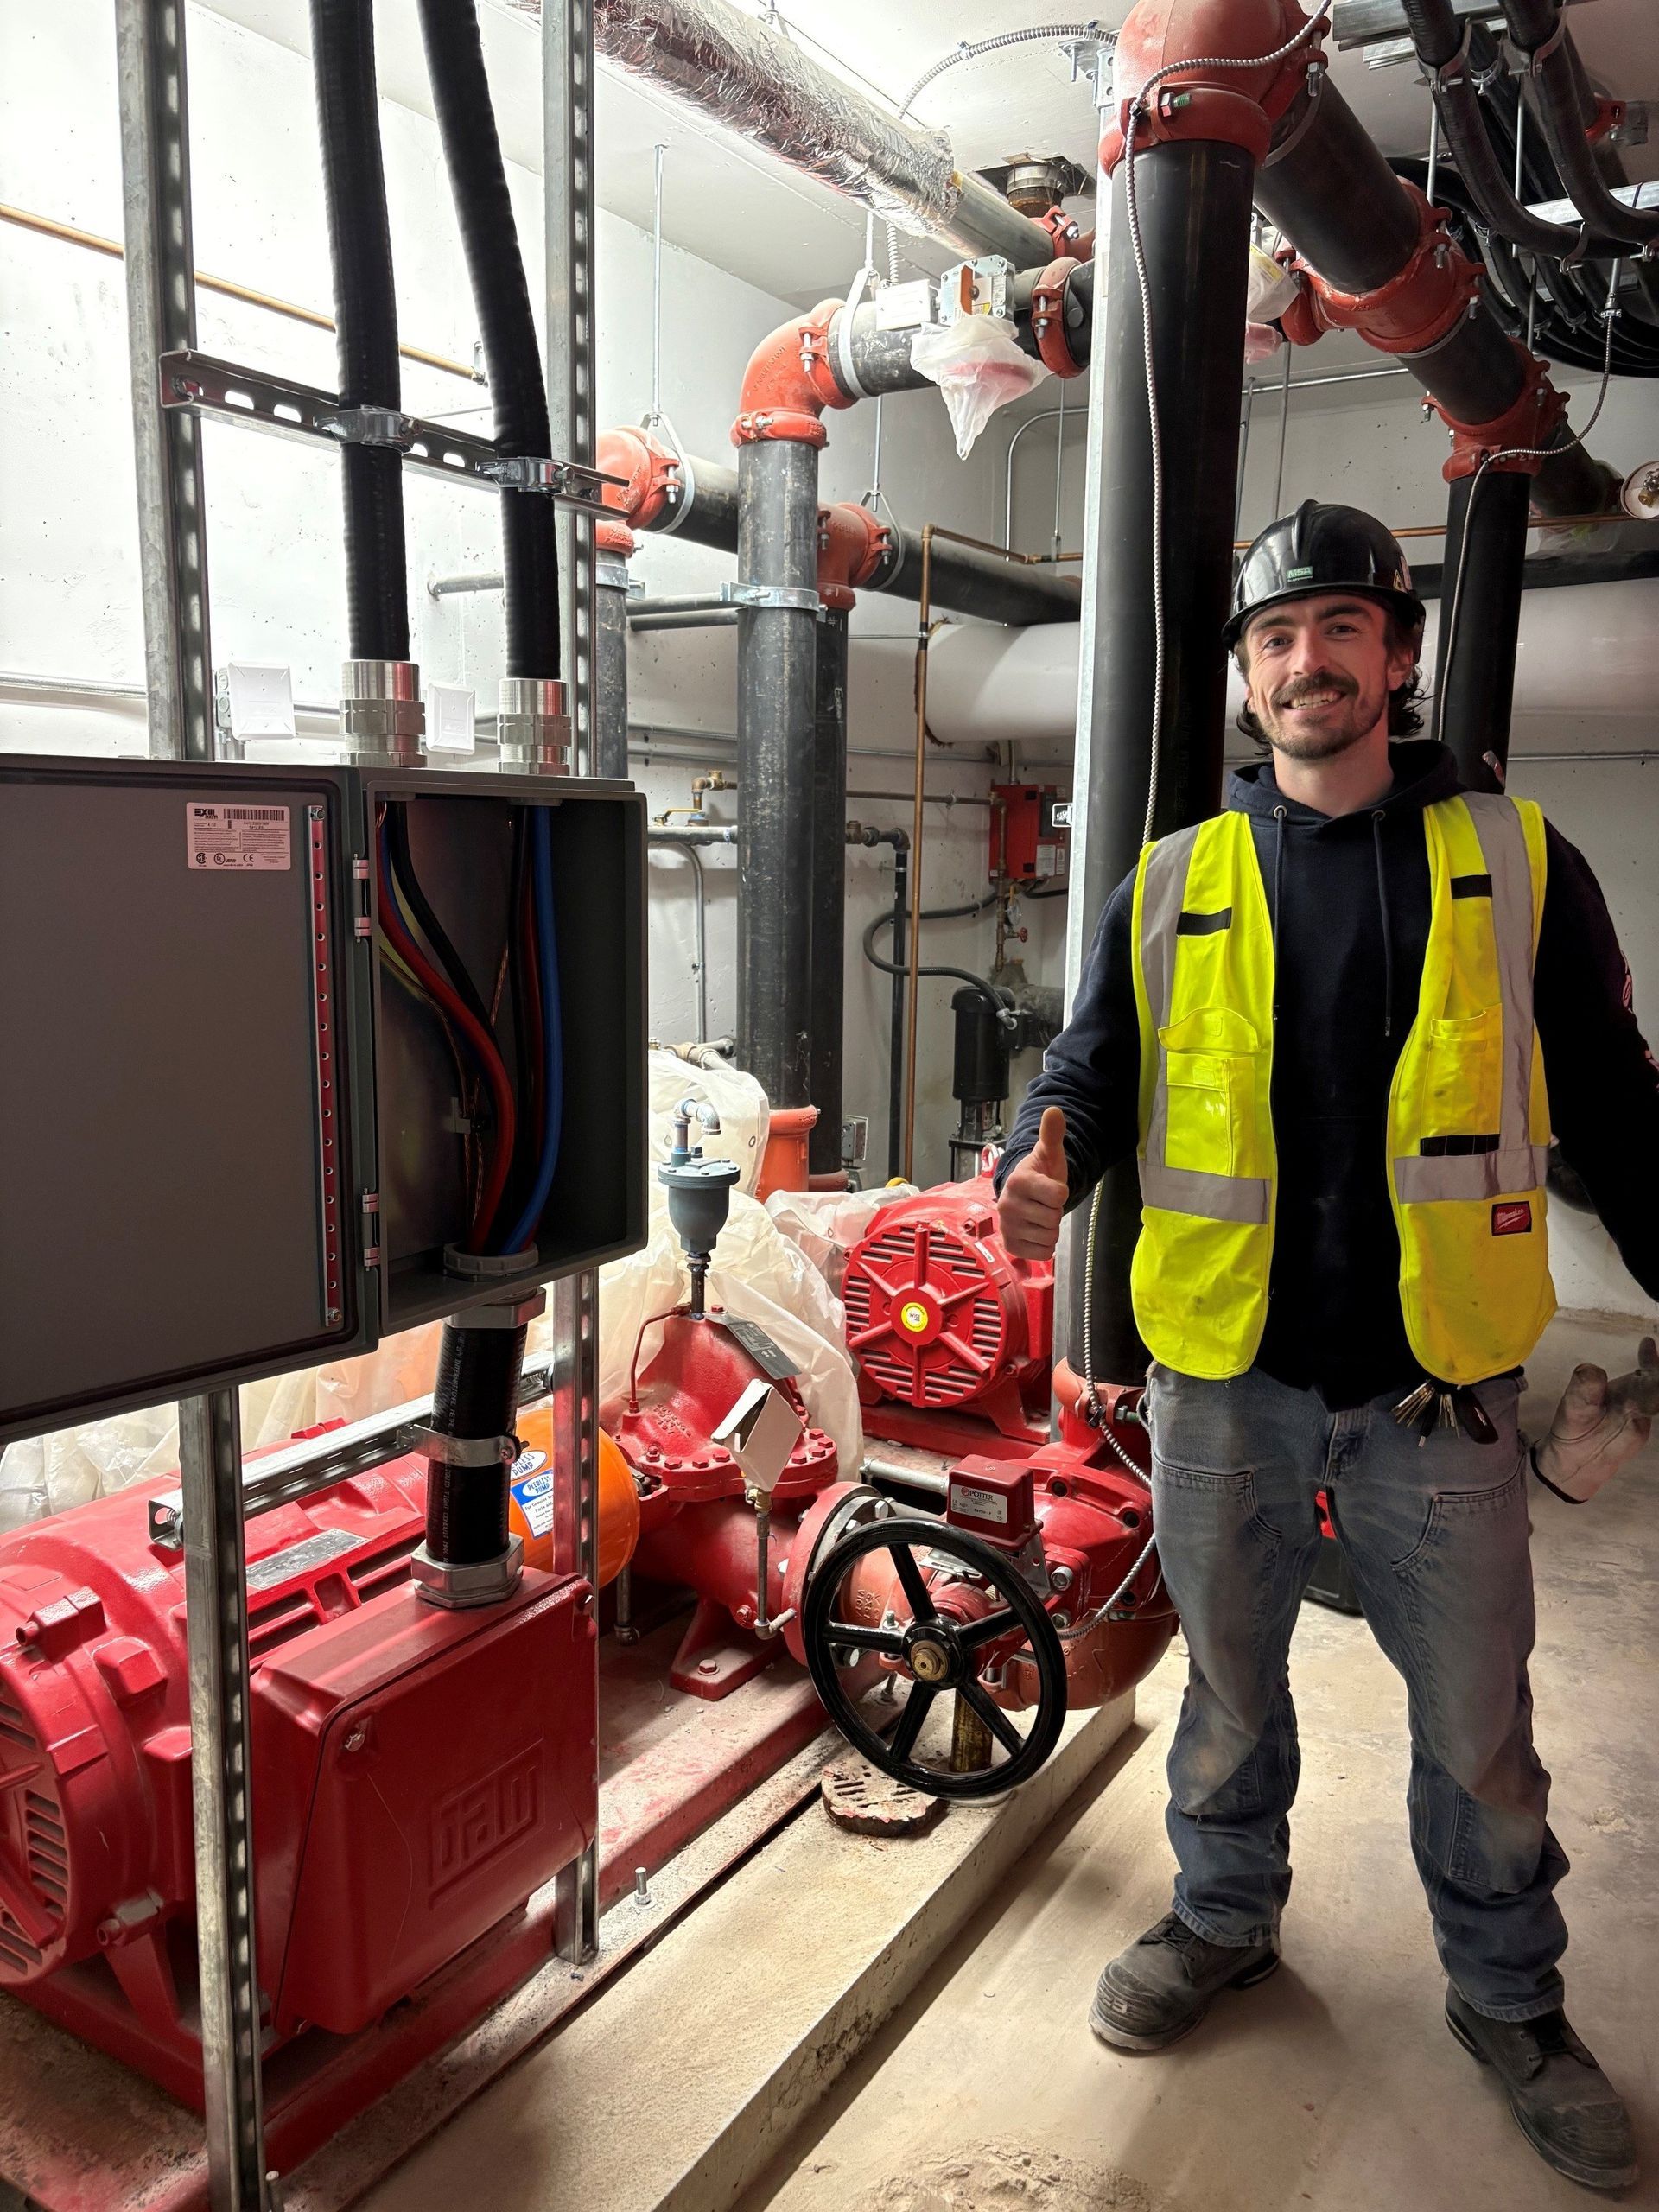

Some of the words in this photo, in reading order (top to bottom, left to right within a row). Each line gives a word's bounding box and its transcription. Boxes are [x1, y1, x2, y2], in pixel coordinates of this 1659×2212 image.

[1287, 567, 1311, 578] MSA
[511, 1452, 536, 1469] RLESS
[512, 1462, 534, 1476] PUMP
[527, 1476, 551, 1491] PEERLESS
[536, 1483, 550, 1494] PUMP
[969, 1490, 993, 1500] POTTER
